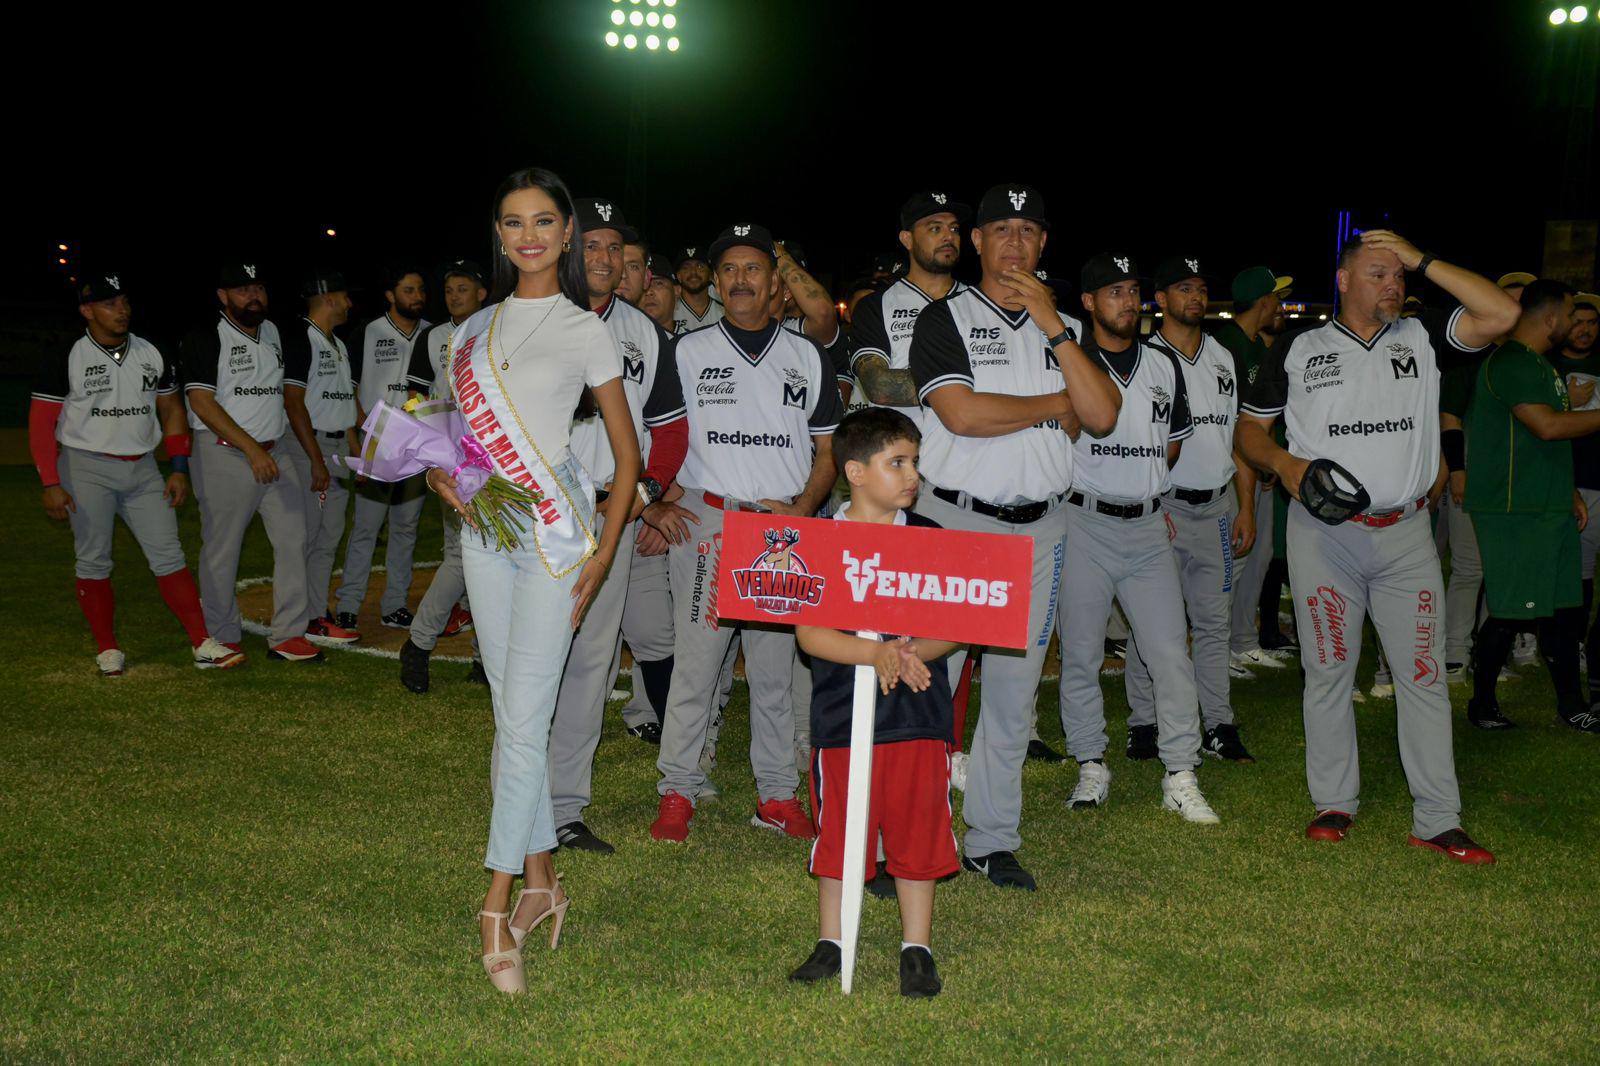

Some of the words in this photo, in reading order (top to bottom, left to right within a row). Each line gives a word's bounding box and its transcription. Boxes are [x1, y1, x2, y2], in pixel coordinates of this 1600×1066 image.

[969, 327, 1001, 339] ms
[85, 363, 107, 377] ms
[1305, 352, 1340, 370] ms
[699, 366, 736, 380] ms
[234, 385, 282, 397] Redpetr
[469, 408, 502, 441] DE
[1328, 416, 1415, 438] Redpetroi
[690, 554, 707, 625] caliente.mx
[733, 569, 824, 606] VENADOS
[842, 549, 1009, 608] VENADOS
[1417, 590, 1433, 614] 30
[1310, 607, 1327, 665] caliente.mx
